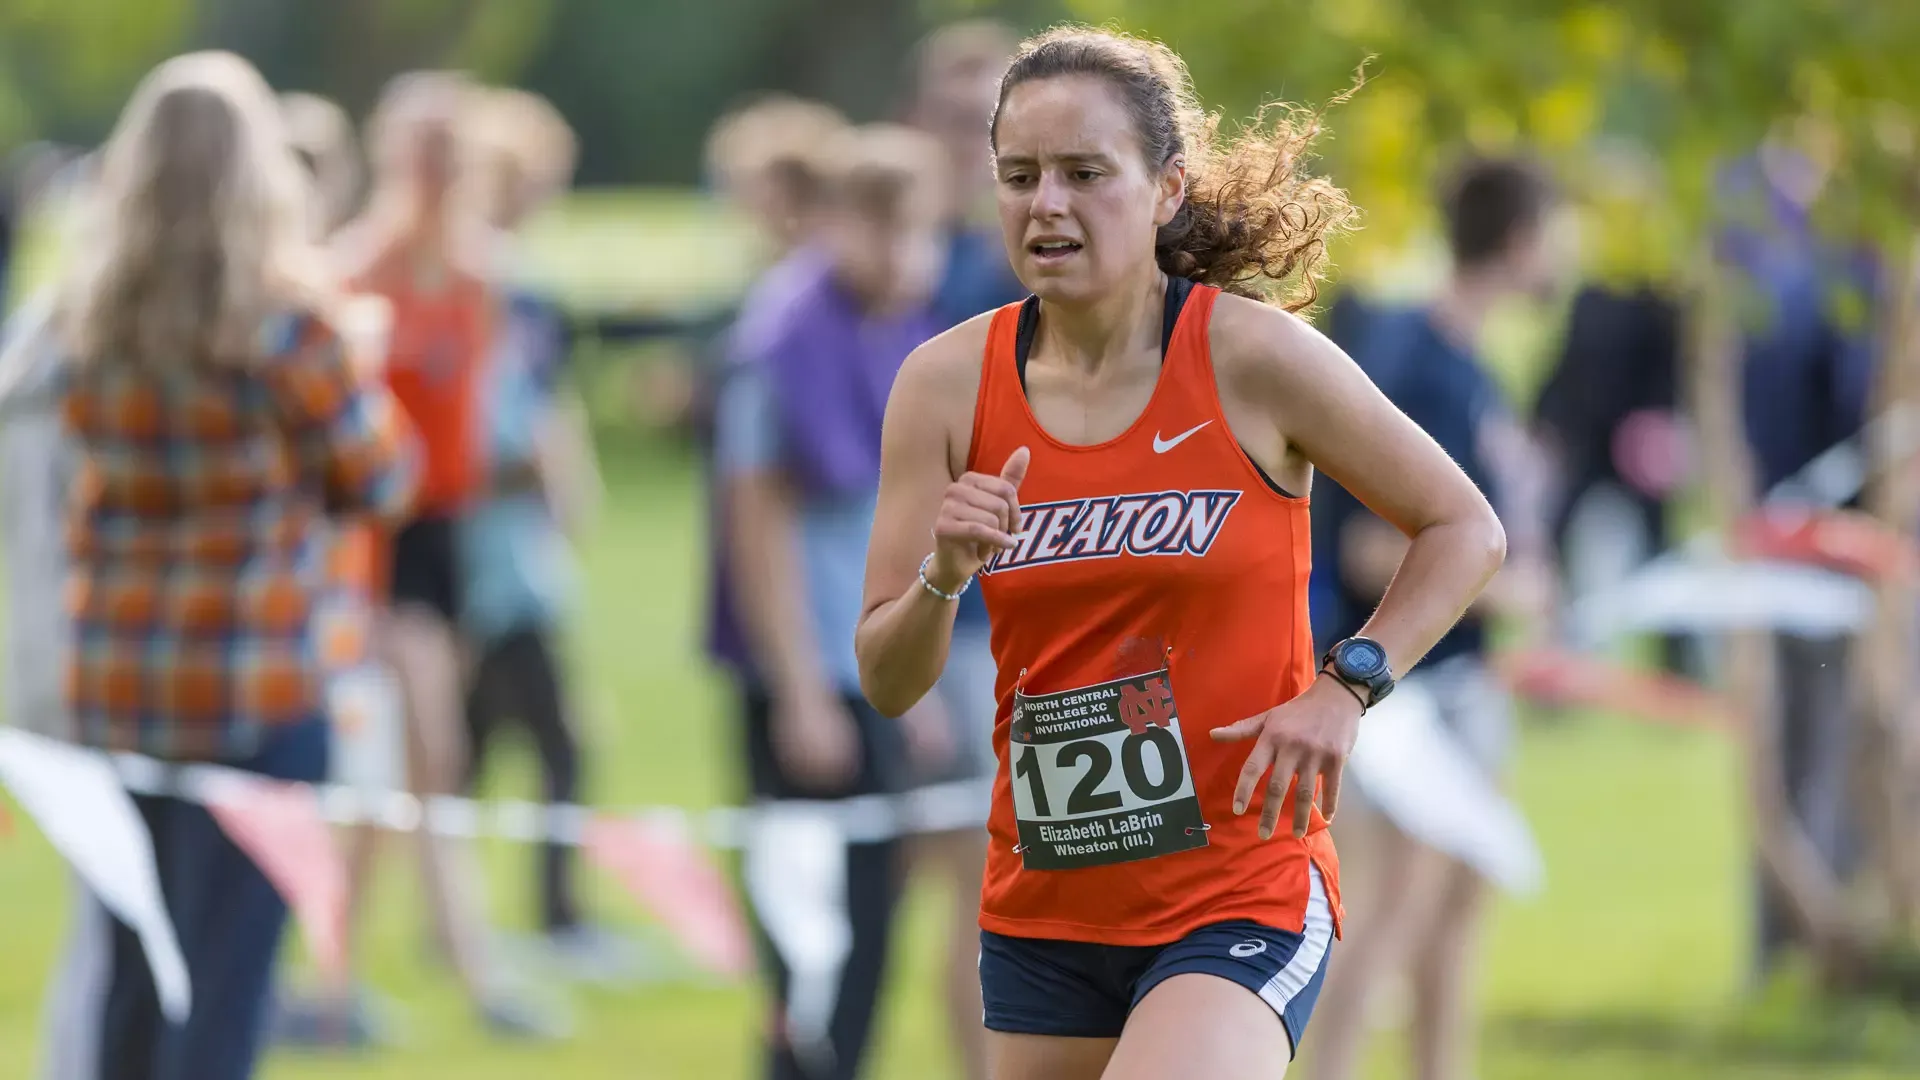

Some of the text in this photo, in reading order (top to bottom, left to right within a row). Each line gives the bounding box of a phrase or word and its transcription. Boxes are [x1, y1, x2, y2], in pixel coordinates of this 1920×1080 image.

[979, 489, 1244, 576] HEATON
[1024, 688, 1118, 712] NORTH CENTRAL
[1035, 702, 1108, 723] COLLEGE XC
[1035, 714, 1115, 735] INVITATIONAL
[1016, 727, 1184, 817] 120
[1039, 812, 1163, 842] Elizabeth LaBrin
[1054, 840, 1118, 856] Wheaton
